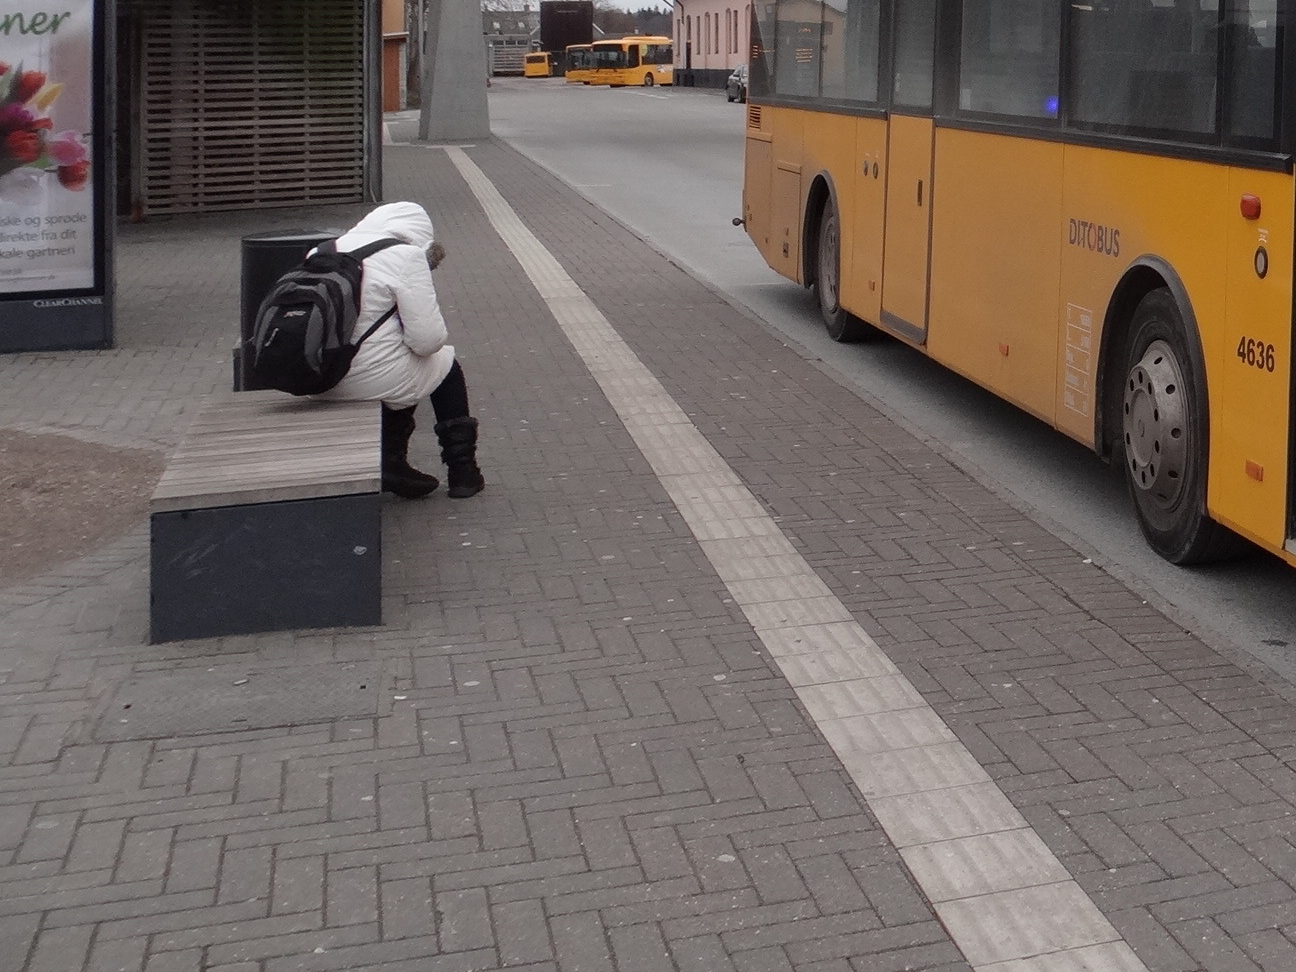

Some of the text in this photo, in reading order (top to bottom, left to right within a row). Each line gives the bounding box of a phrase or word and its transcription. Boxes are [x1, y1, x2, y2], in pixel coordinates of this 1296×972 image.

[24, 216, 41, 228] og
[1069, 218, 1120, 258] DITOBUS
[1237, 336, 1275, 373] 4636
